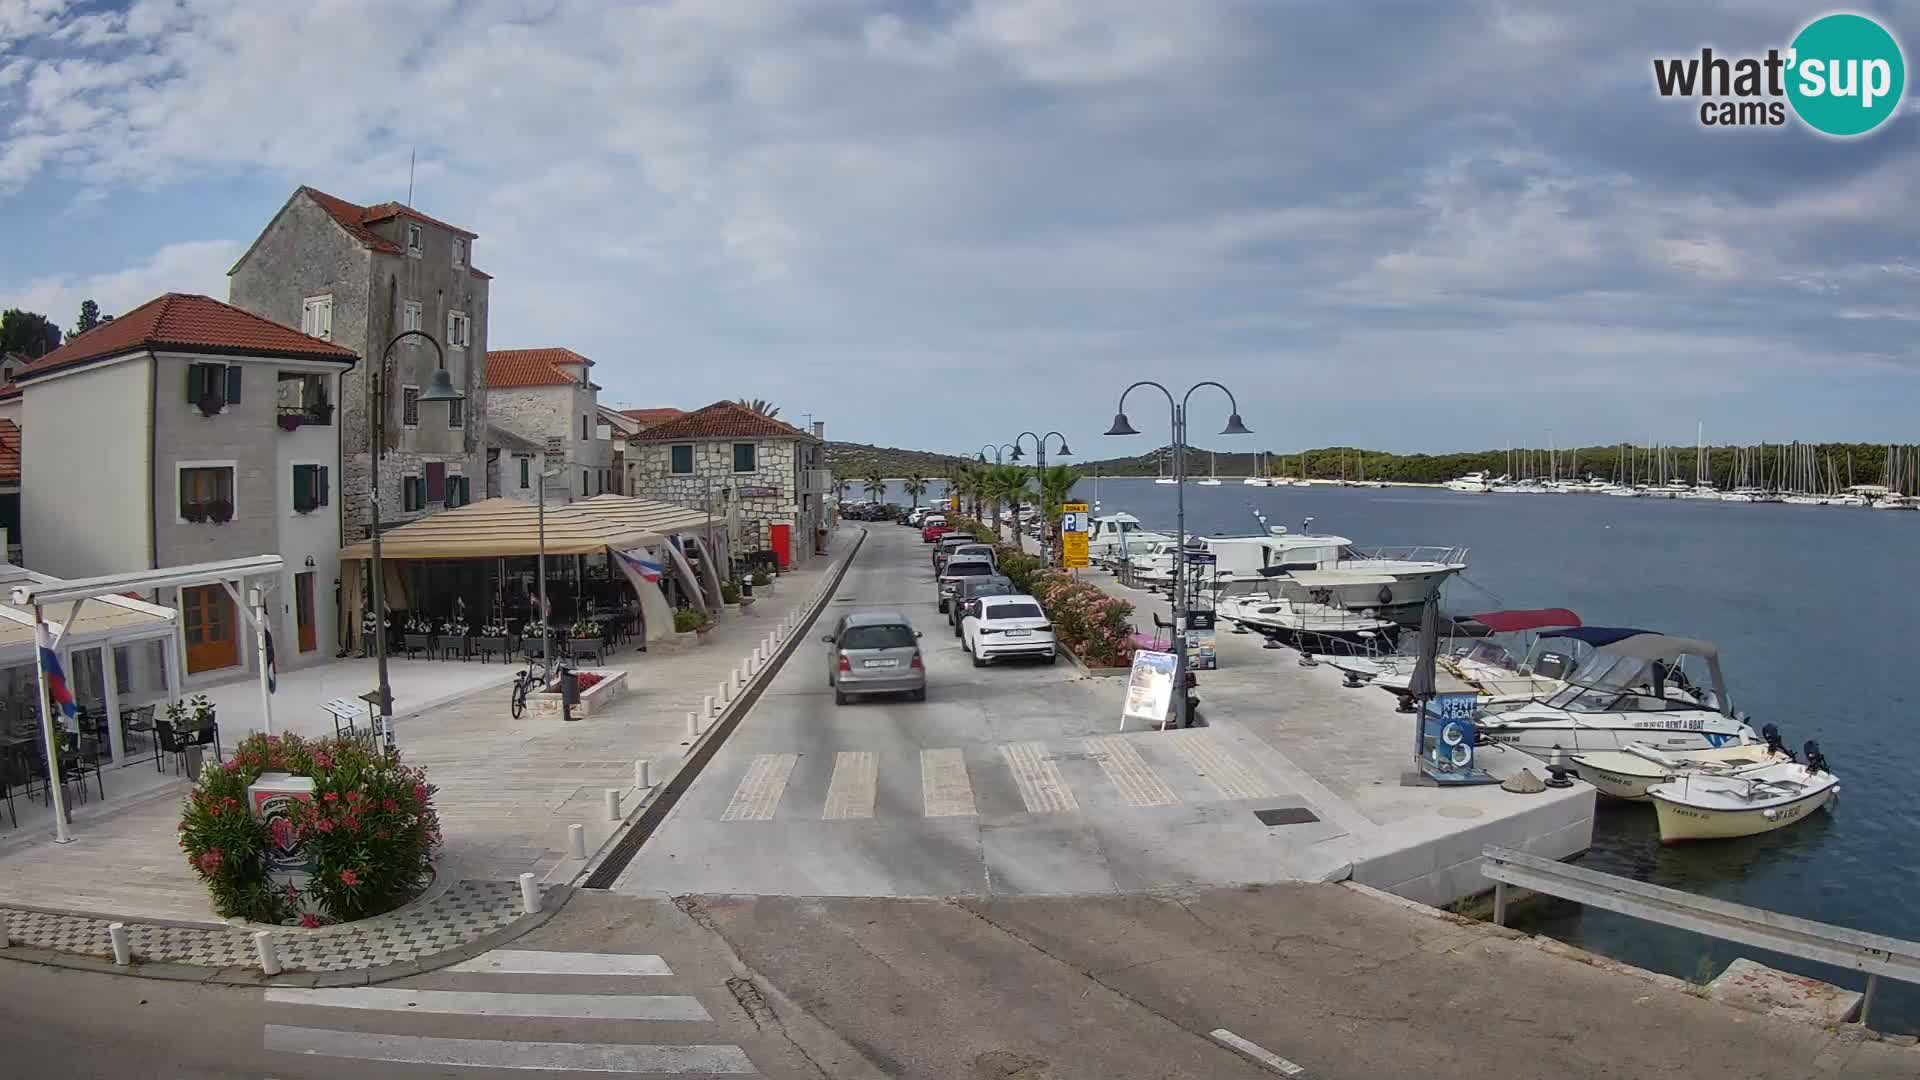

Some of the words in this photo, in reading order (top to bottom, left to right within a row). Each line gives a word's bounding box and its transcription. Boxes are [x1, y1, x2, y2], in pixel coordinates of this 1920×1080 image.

[1064, 514, 1075, 530] P
[1443, 698, 1475, 710] RENT
[1442, 710, 1449, 719] A
[1451, 709, 1474, 719] BOAT
[1665, 720, 1682, 729] RENT
[1688, 719, 1704, 730] BOAT
